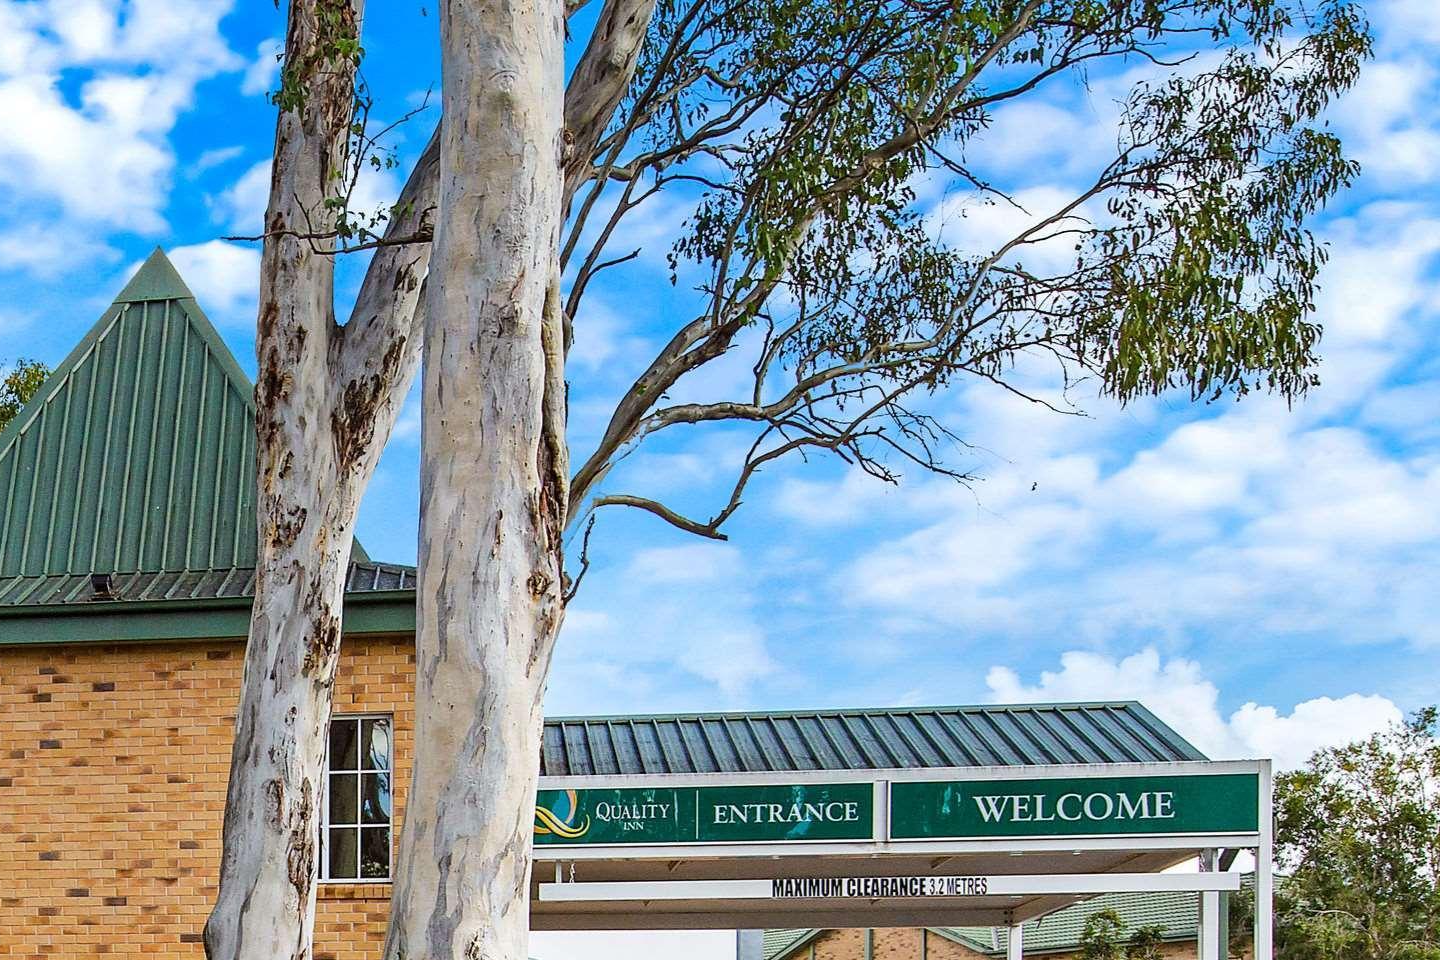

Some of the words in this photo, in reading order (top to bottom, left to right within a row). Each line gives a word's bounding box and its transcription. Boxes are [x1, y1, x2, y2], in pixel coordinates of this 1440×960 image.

[595, 801, 670, 821] QUALITY
[713, 802, 859, 824] ENTRANCE
[972, 791, 1176, 823] WELCOME
[624, 821, 645, 831] INN
[772, 879, 843, 897] MAXIMUM
[847, 878, 926, 897] CLEARANCE
[929, 878, 944, 895] 3.2
[947, 877, 988, 895] METRES
